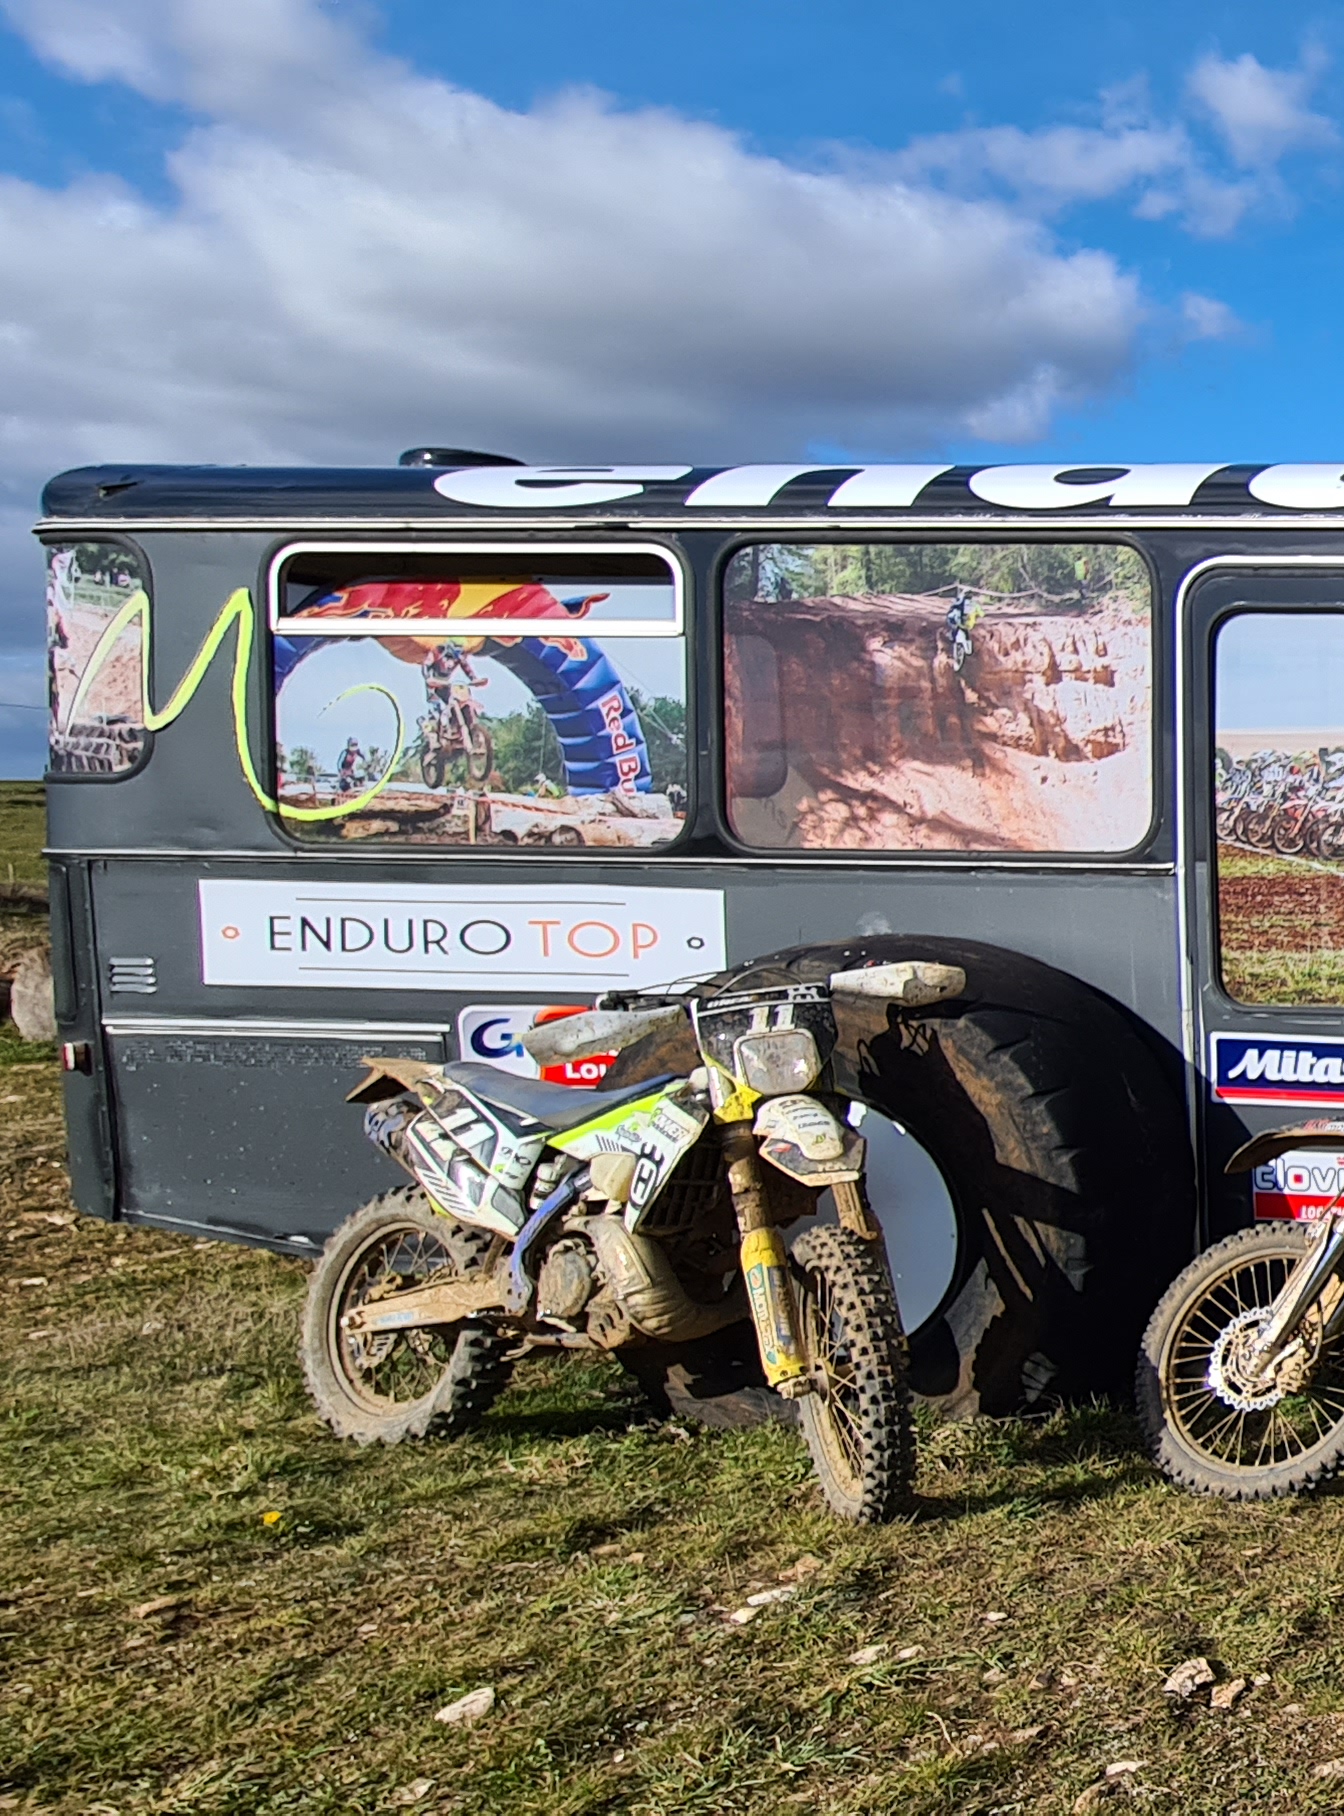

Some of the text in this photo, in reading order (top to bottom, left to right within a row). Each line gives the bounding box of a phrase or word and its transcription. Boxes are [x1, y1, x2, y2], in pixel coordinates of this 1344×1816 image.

[600, 694, 640, 795] Red Bu
[268, 914, 659, 960] ENDURO TOP
